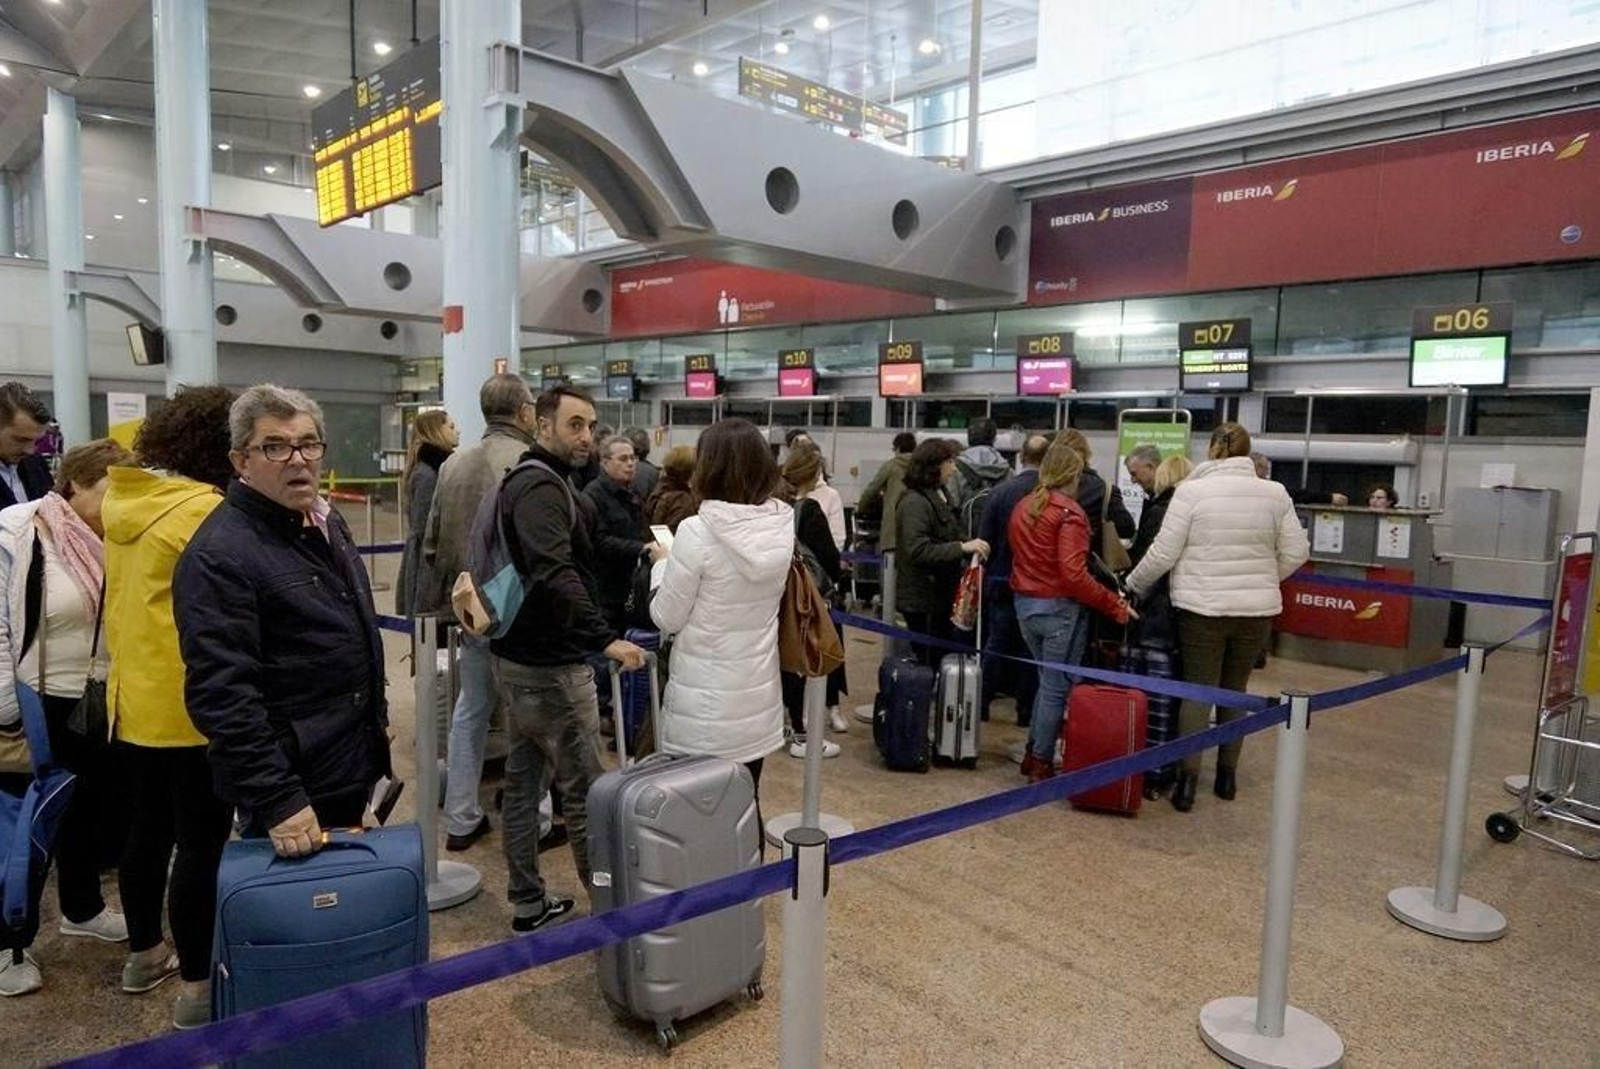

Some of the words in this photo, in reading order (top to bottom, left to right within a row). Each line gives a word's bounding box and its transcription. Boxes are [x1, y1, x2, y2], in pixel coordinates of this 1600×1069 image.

[1476, 141, 1555, 163] IBERIA
[1217, 185, 1274, 204] IBERIA
[1050, 211, 1095, 228] IBERIA
[1112, 200, 1169, 218] BUSINESS
[1454, 307, 1489, 331] 06
[1209, 323, 1235, 344] 07
[897, 344, 913, 360] 09
[1041, 336, 1061, 353] 08
[793, 350, 807, 365] 10
[1296, 592, 1355, 613] IBERIA
